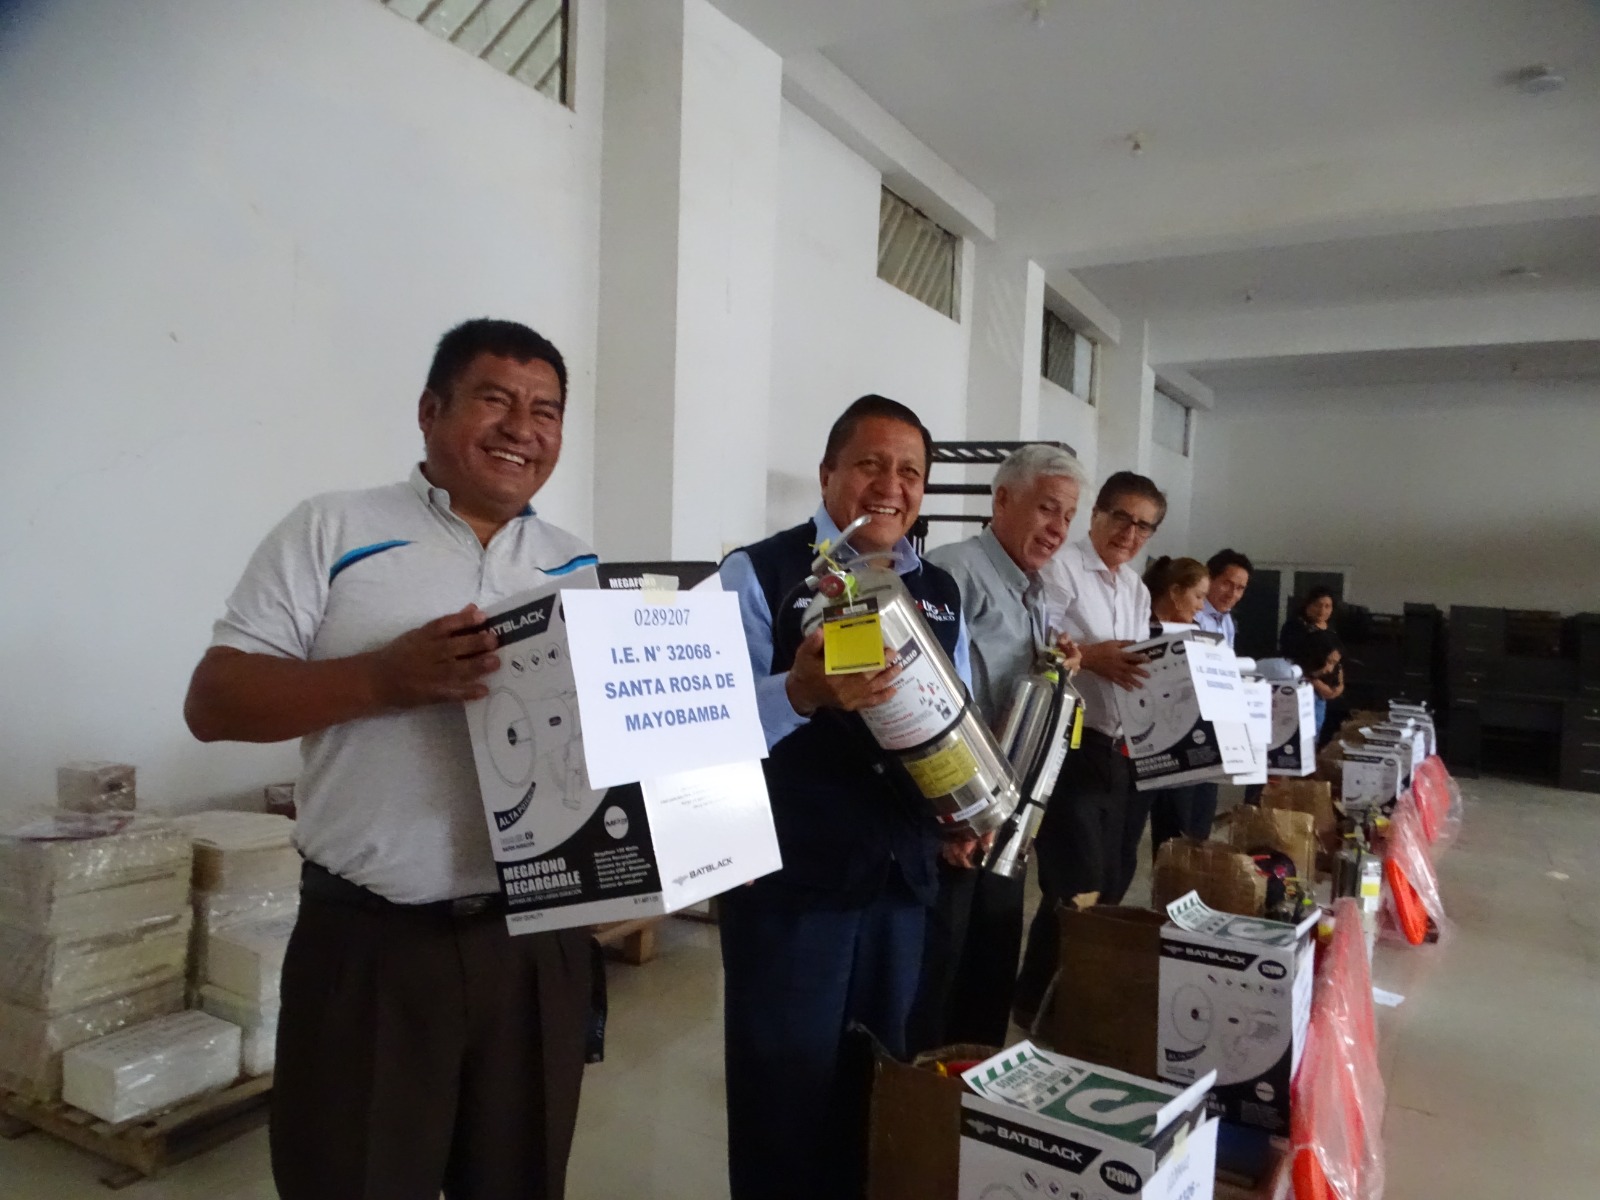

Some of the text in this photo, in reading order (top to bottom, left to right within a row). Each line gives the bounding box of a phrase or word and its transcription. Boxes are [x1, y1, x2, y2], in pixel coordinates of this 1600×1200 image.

[489, 608, 546, 636] ATBLACK
[634, 608, 690, 626] 0289207
[610, 646, 640, 664] I.E.
[666, 643, 712, 661] 32068
[604, 672, 736, 699] SANTA ROSA DE
[625, 704, 731, 732] MAYOBAMBA
[500, 810, 519, 828] ALTA
[503, 857, 567, 881] MEGAFONO
[689, 857, 733, 879] BATBLACK
[505, 870, 582, 895] RECARGABLE
[997, 1126, 1084, 1164] BATBLACK
[1105, 1166, 1137, 1189] 120W
